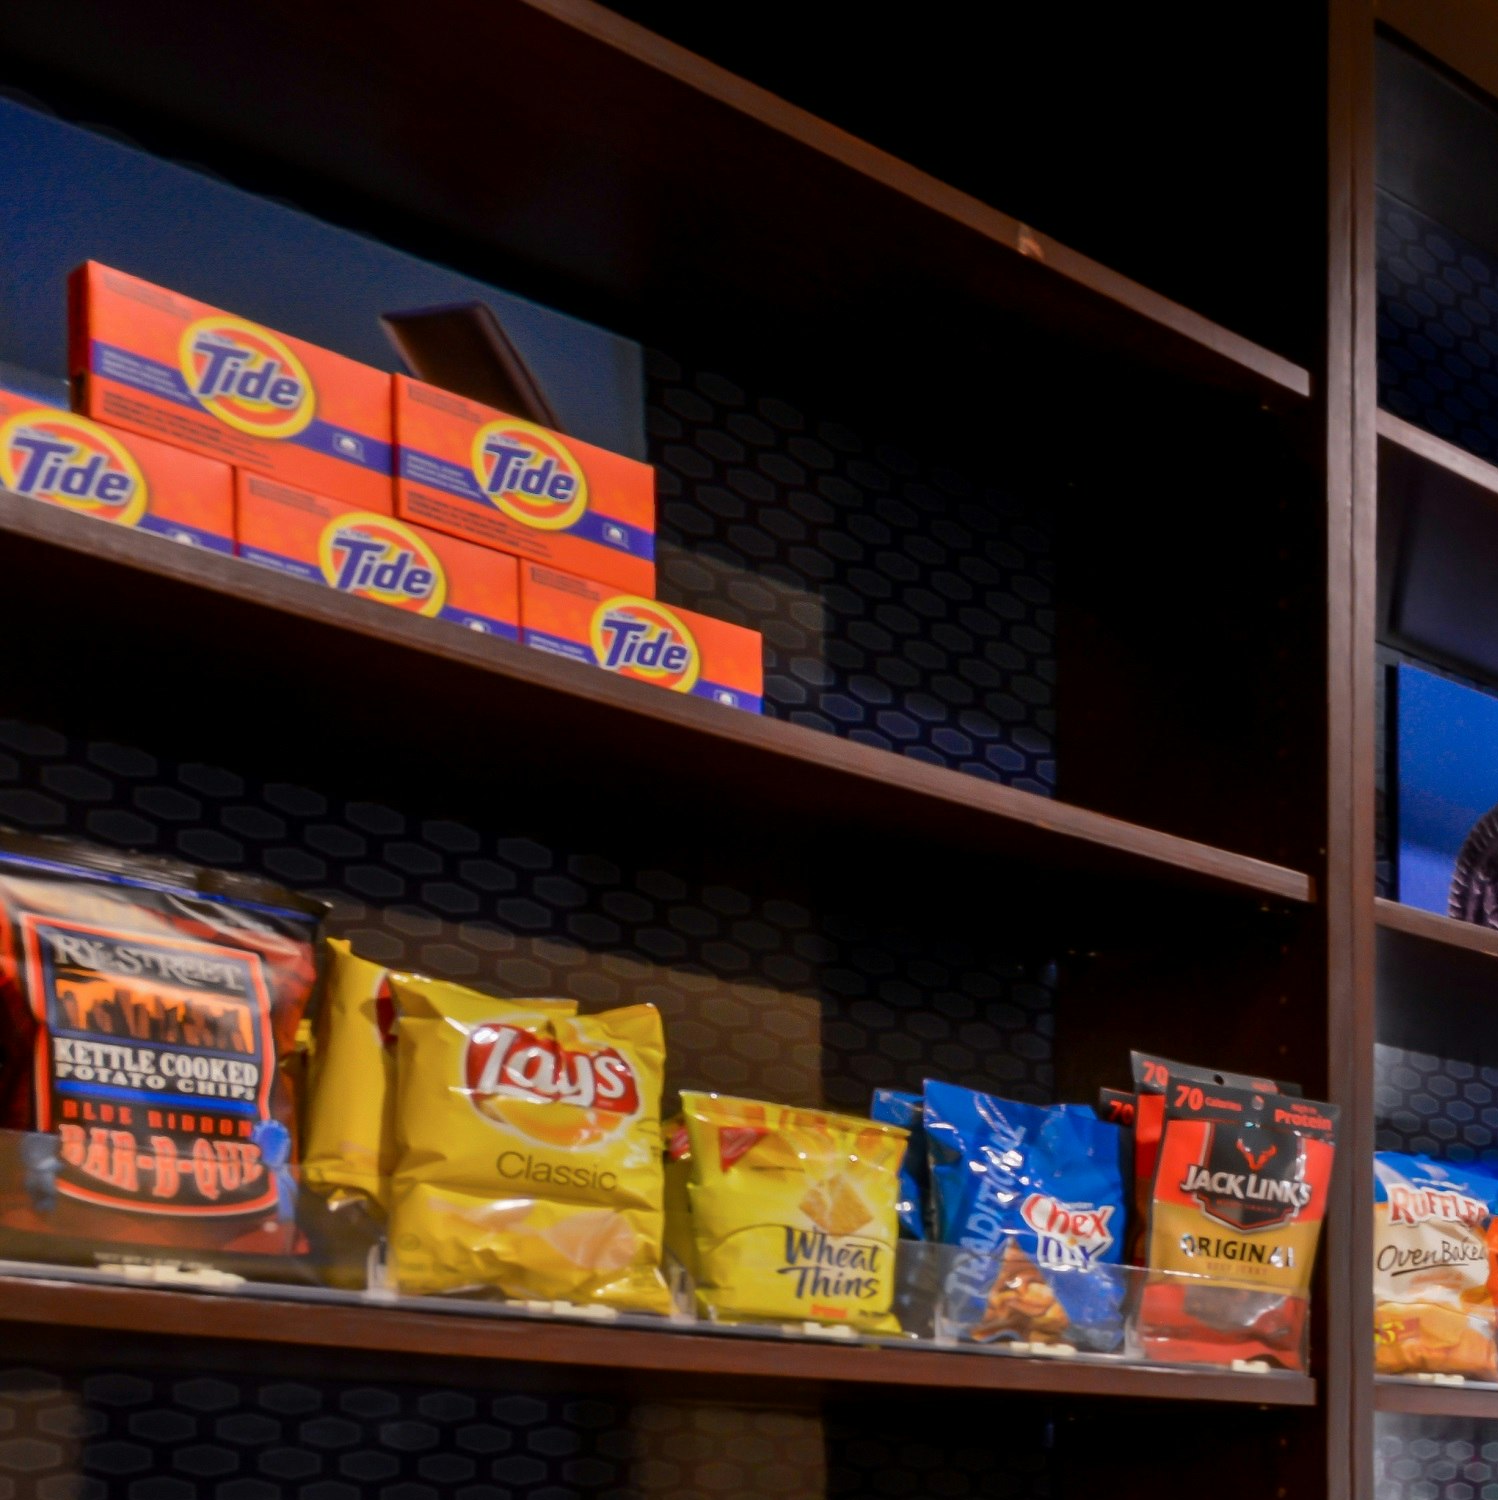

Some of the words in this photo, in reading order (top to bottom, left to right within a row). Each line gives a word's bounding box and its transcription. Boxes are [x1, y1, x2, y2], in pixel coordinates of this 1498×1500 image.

[194, 341, 300, 408] Tide
[9, 432, 131, 500] Tide
[484, 442, 575, 500] Tide
[334, 536, 432, 600] Tide
[602, 618, 688, 672] Tide
[55, 1037, 156, 1074] KETTLE
[160, 1053, 258, 1086] COOKED
[56, 1063, 166, 1089] POTATO
[177, 1079, 255, 1100] CHIPS
[1174, 1085, 1204, 1111] 70
[496, 1150, 618, 1193] Classic
[1181, 1165, 1244, 1199] JACK
[1022, 1193, 1111, 1236] Chex
[784, 1227, 879, 1274] Wheat
[1180, 1233, 1296, 1268] ORIGINAL
[778, 1266, 878, 1299] Thins
